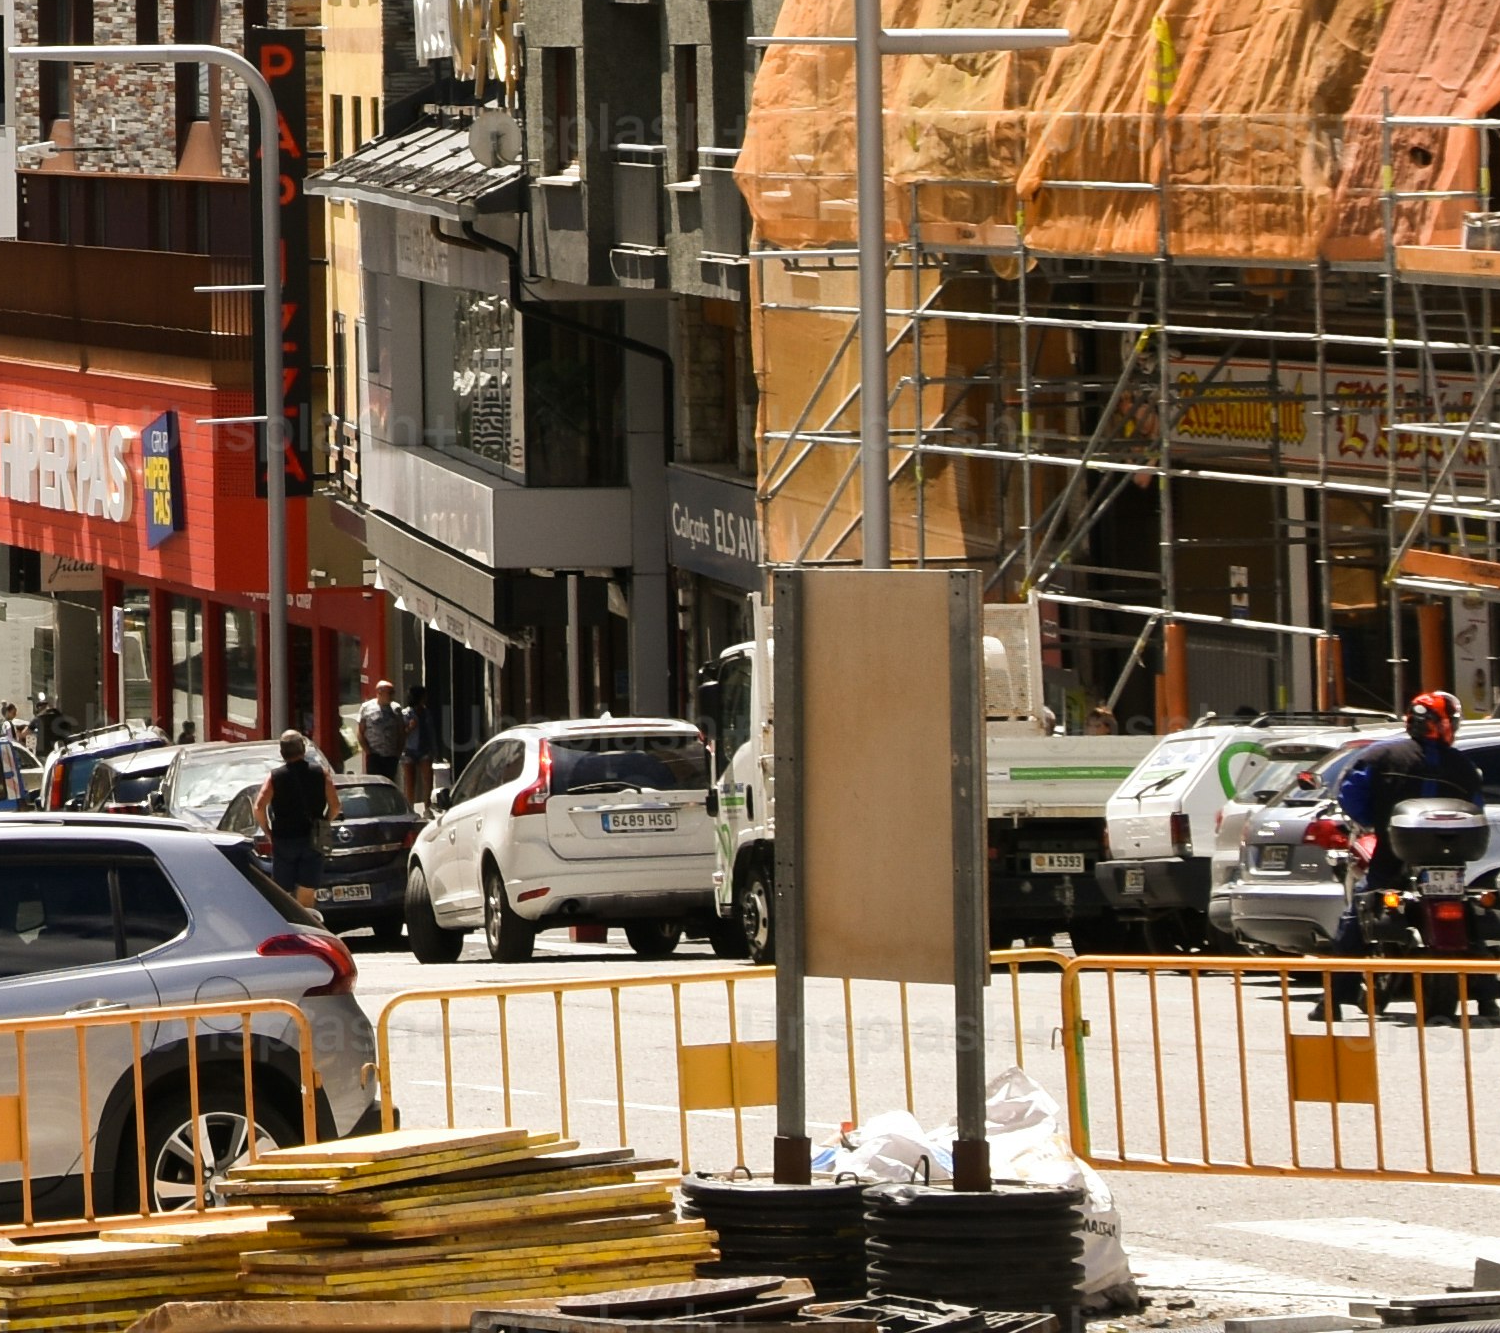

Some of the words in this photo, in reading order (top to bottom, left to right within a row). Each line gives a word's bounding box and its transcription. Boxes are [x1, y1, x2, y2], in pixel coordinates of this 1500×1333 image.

[672, 502, 710, 550] Calçats
[713, 508, 735, 557] ELS
[611, 813, 645, 828] 6489
[648, 813, 673, 828] HSG
[1057, 855, 1081, 868] 5393
